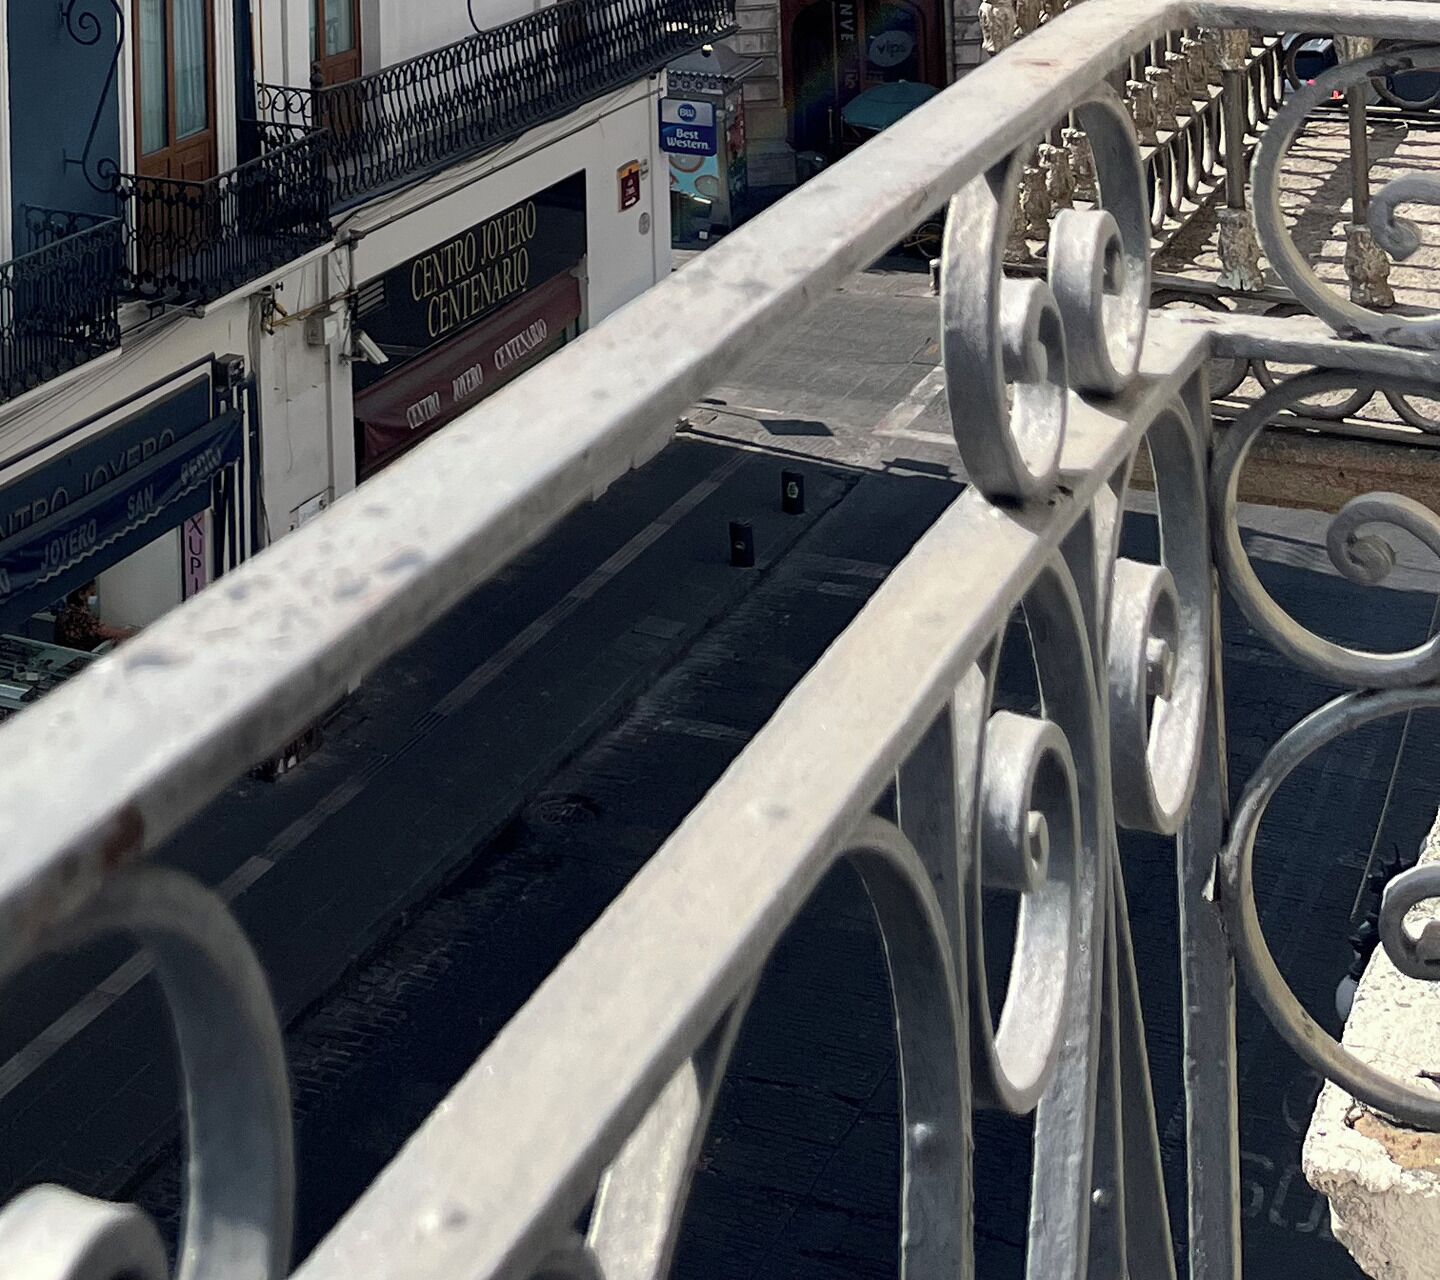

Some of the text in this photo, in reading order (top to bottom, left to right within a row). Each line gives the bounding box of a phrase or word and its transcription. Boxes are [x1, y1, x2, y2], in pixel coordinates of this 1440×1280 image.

[666, 136, 710, 151] Western
[675, 127, 699, 140] Best
[411, 200, 537, 301] CENTRO JOYERO
[427, 248, 530, 338] CENTENARIO
[406, 319, 548, 429] CENTRO JOYERO CENTENARIO
[42, 518, 96, 570] JOYERO
[127, 485, 154, 521] SAN
